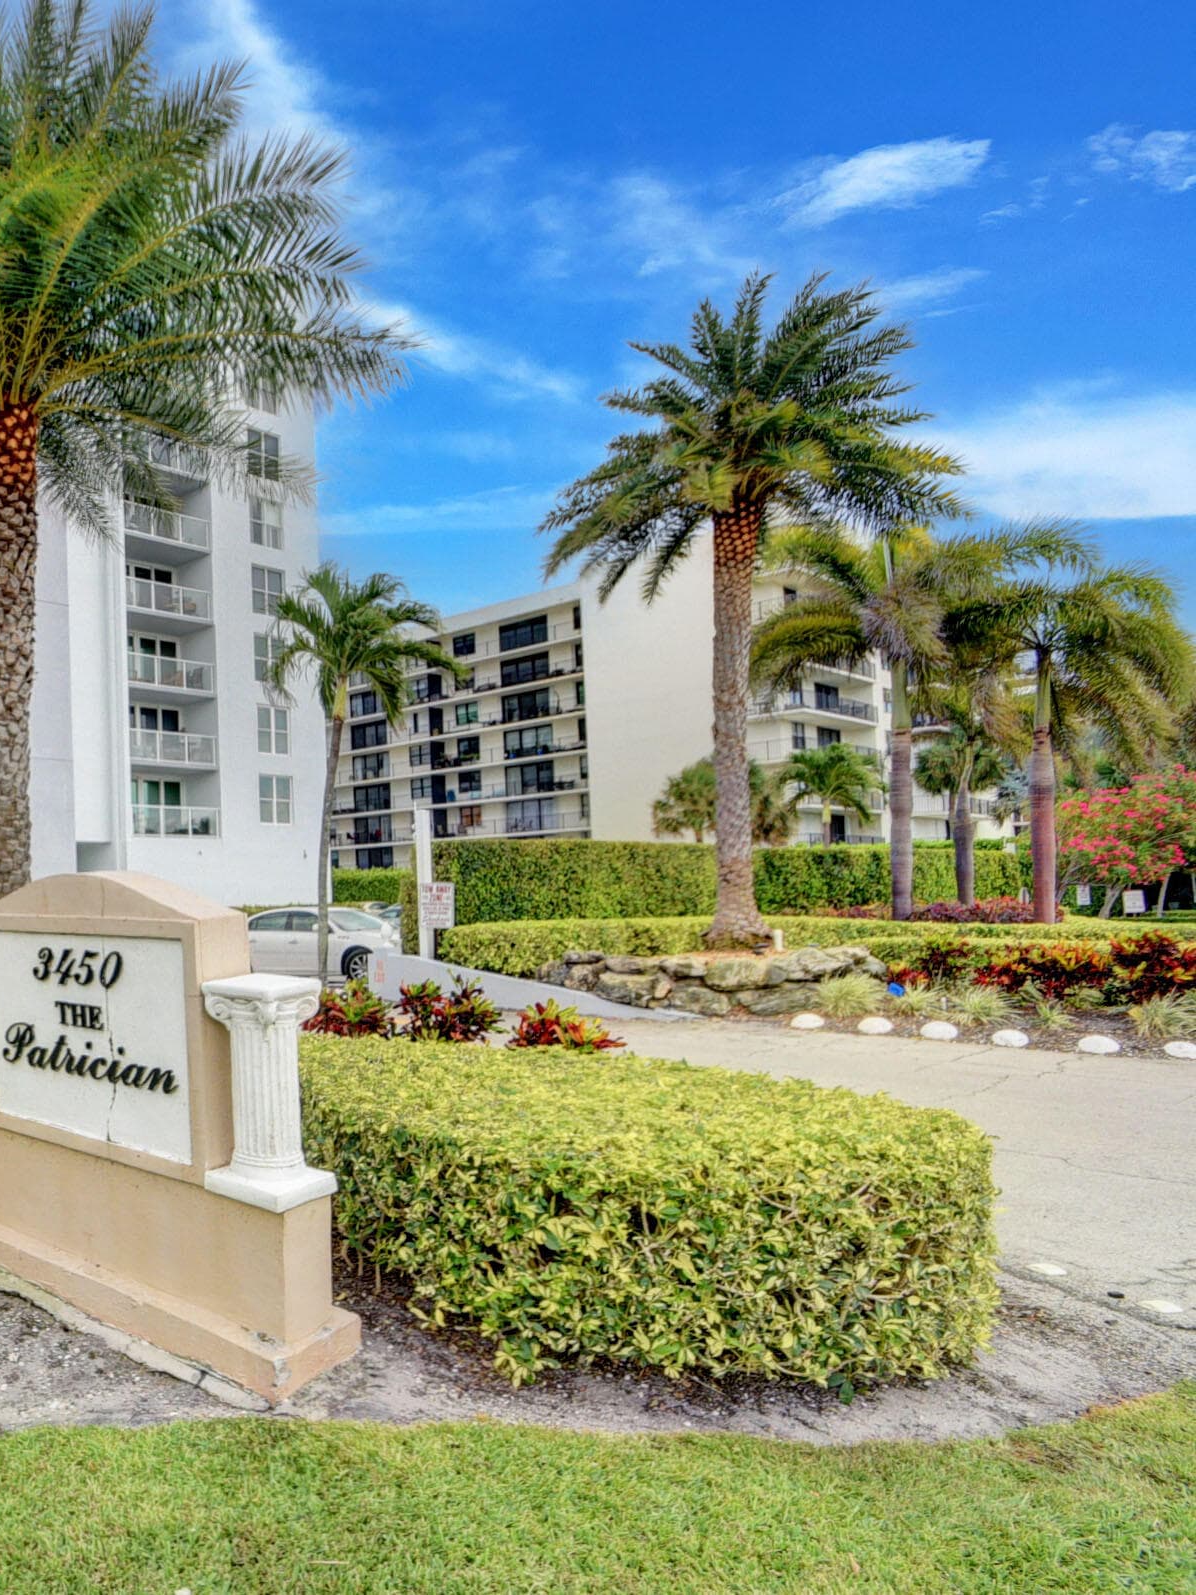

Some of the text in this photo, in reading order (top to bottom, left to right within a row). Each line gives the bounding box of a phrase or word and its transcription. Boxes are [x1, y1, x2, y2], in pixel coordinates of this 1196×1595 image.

[32, 947, 123, 989] 3450
[55, 1001, 104, 1031] THE
[2, 1022, 179, 1095] Patrician
